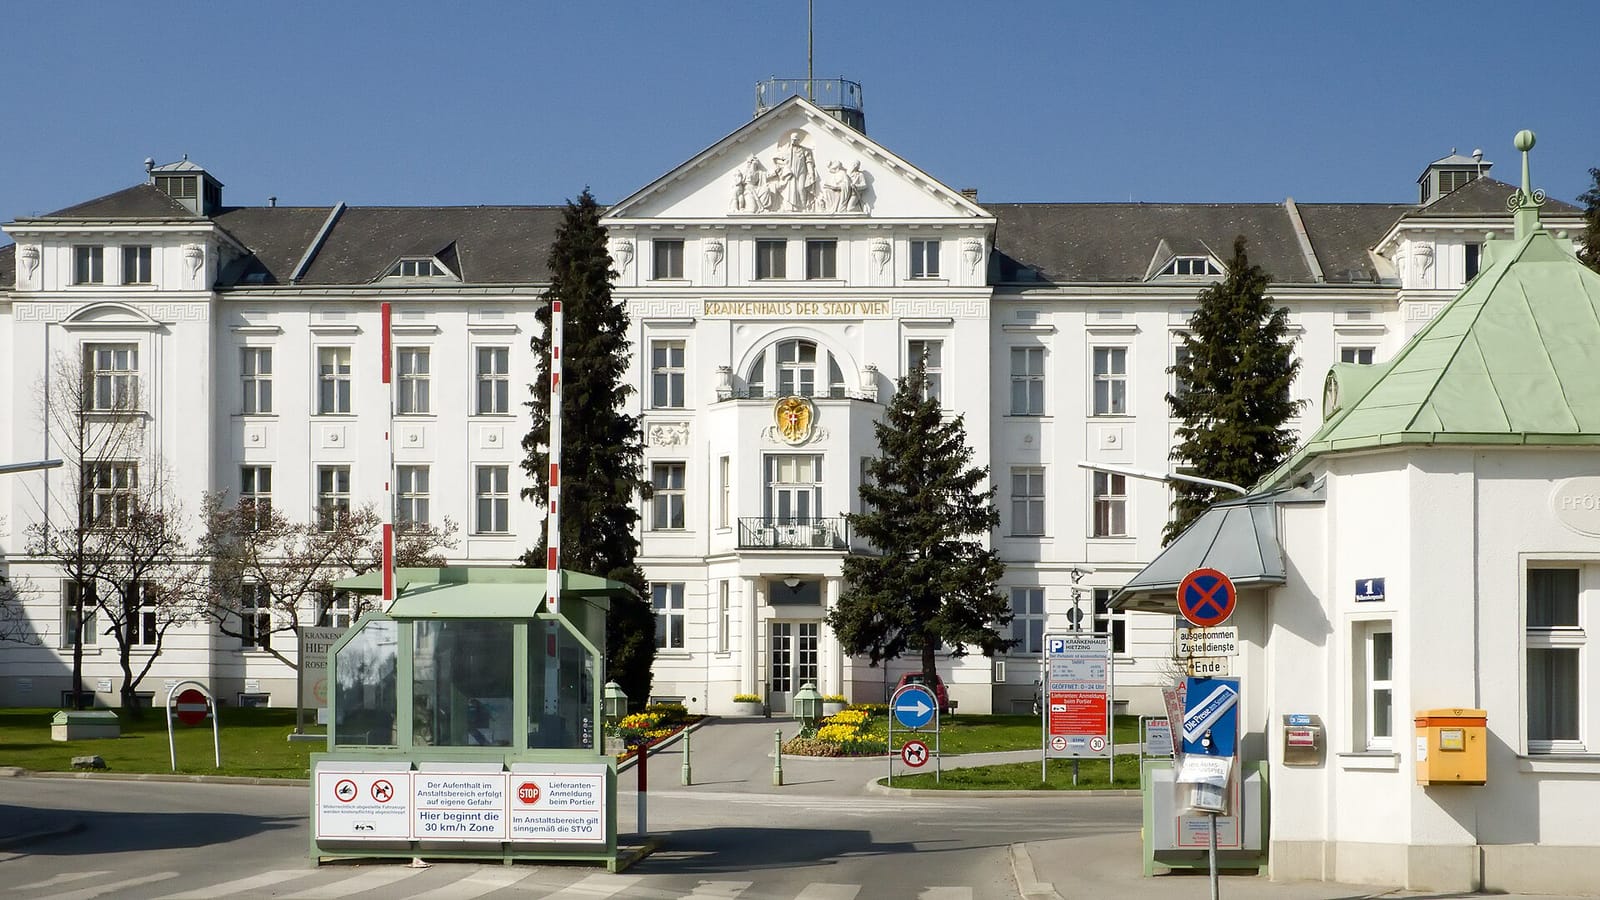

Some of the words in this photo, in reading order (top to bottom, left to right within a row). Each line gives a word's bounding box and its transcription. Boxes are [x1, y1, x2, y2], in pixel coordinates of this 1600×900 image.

[704, 302, 792, 315] KRANKENHAUS
[796, 302, 819, 315] DER
[823, 302, 858, 315] STADT
[860, 302, 889, 315] WIEN
[1561, 494, 1600, 511] PFÖ
[1364, 579, 1374, 594] 1
[304, 632, 343, 640] KRANKEN
[1180, 631, 1235, 642] ausgenommen
[1051, 640, 1064, 653] P
[1181, 642, 1235, 653] Zustelldienste
[1195, 660, 1221, 673] Ende
[1184, 718, 1197, 731] Die
[1193, 705, 1211, 724] Presse
[1093, 740, 1102, 749] 30
[519, 788, 539, 798] STOP
[549, 790, 592, 798] Anmeldung
[420, 811, 441, 820] Hier
[443, 812, 482, 822] beginnt
[483, 812, 500, 820] die
[586, 817, 599, 825] gilt
[425, 823, 438, 831] 30
[440, 823, 467, 832] km/h
[469, 823, 495, 832] Zone
